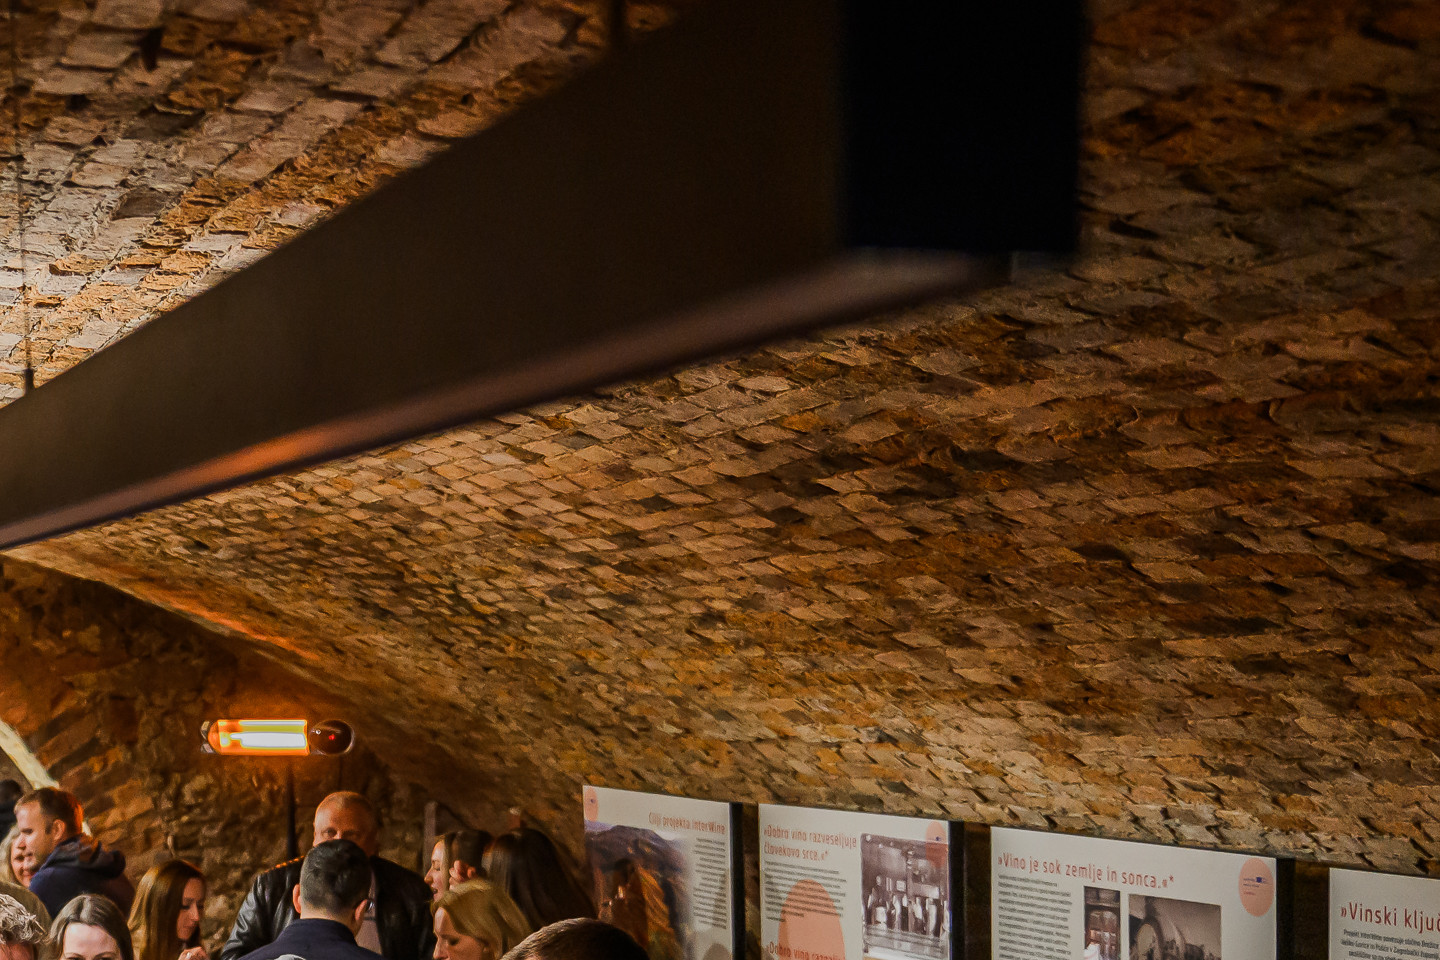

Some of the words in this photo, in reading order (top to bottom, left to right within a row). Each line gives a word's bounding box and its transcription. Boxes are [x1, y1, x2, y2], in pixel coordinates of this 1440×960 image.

[663, 816, 690, 830] projekta
[792, 830, 807, 842] vino
[809, 832, 857, 850] razveseljuje
[997, 852, 1026, 870] »Vino
[1029, 855, 1039, 874] je
[1043, 859, 1060, 875] sok
[1065, 863, 1103, 883] zemlje
[1107, 866, 1117, 882] in
[1341, 902, 1397, 926] »Vinski
[793, 949, 809, 960] vino
